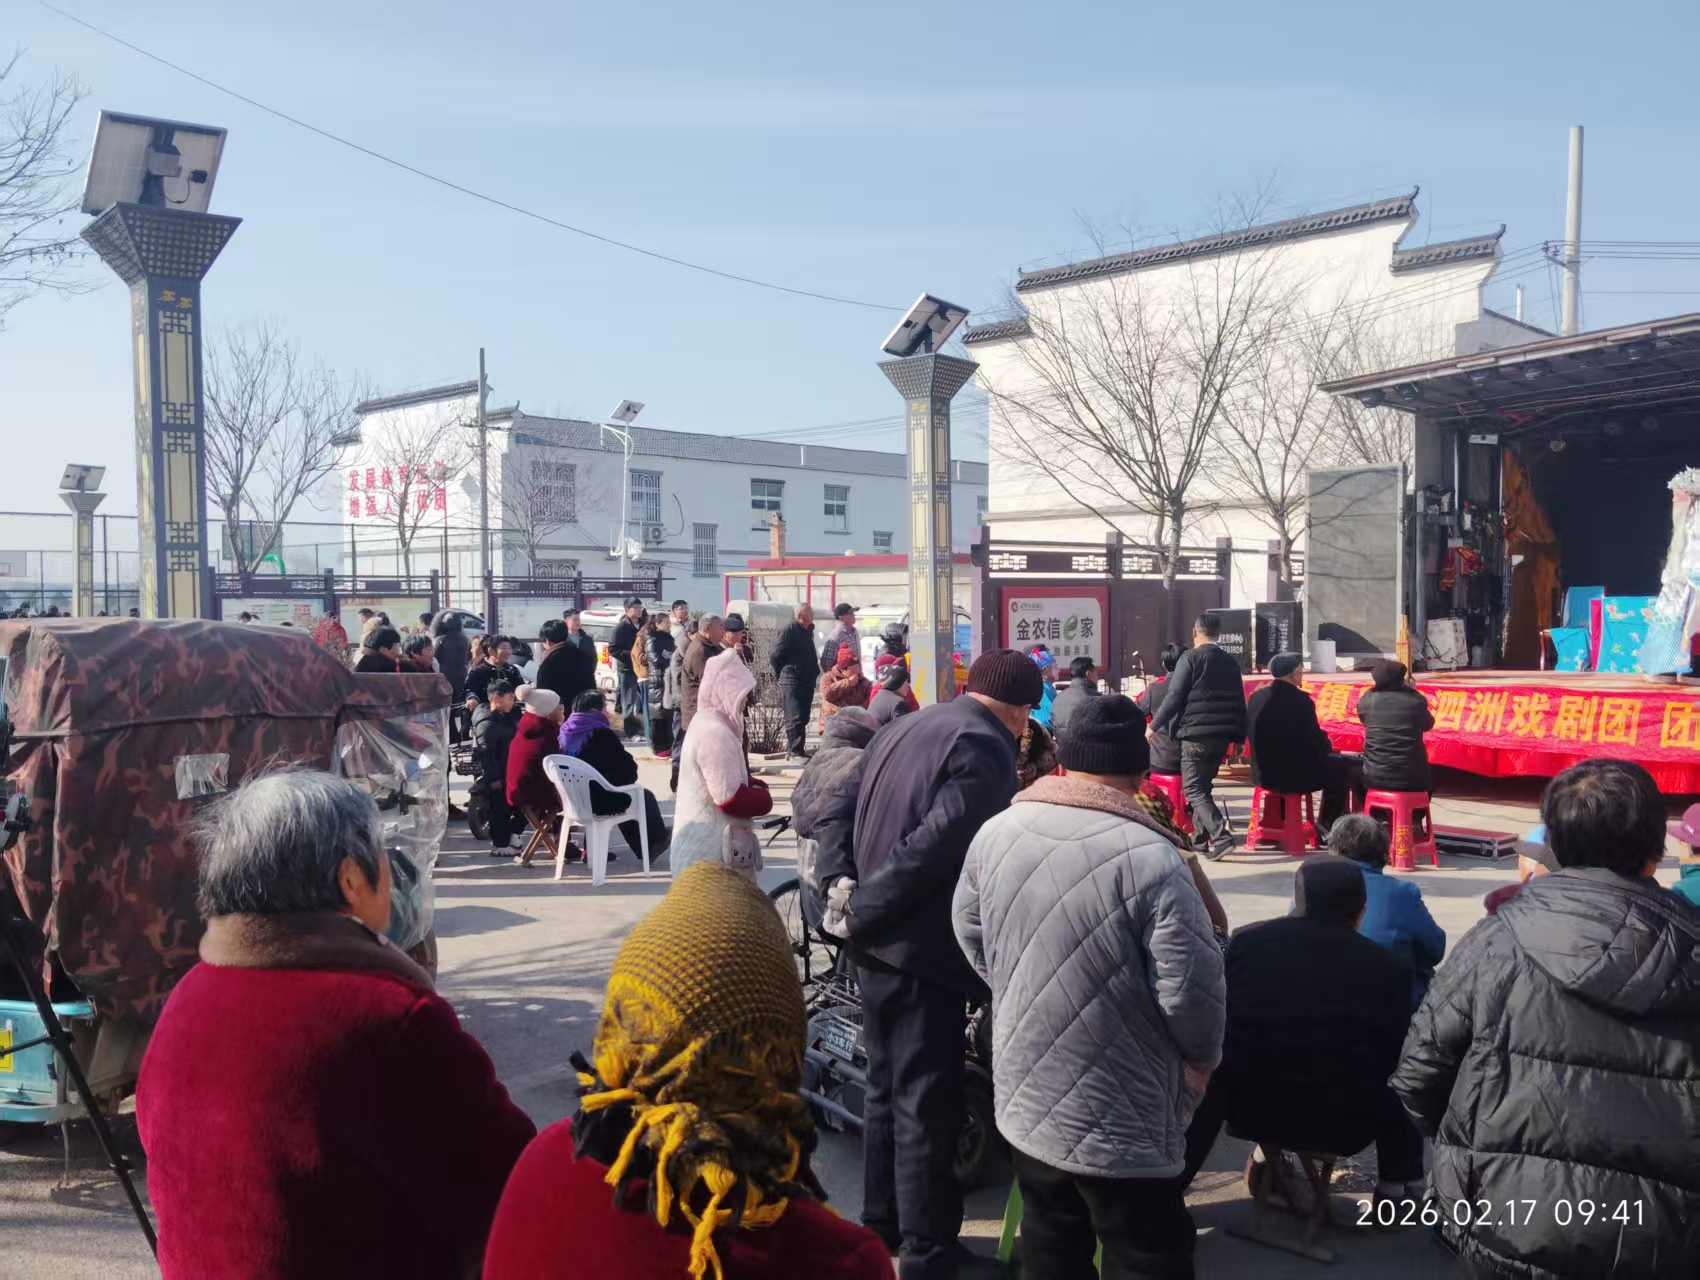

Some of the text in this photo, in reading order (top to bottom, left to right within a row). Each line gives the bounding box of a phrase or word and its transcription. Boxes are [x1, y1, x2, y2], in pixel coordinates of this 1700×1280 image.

[349, 459, 446, 491] 发展体育运
[349, 487, 447, 518] 增强人体质
[1016, 615, 1094, 641] 金农信e家
[1659, 701, 1700, 750] 团
